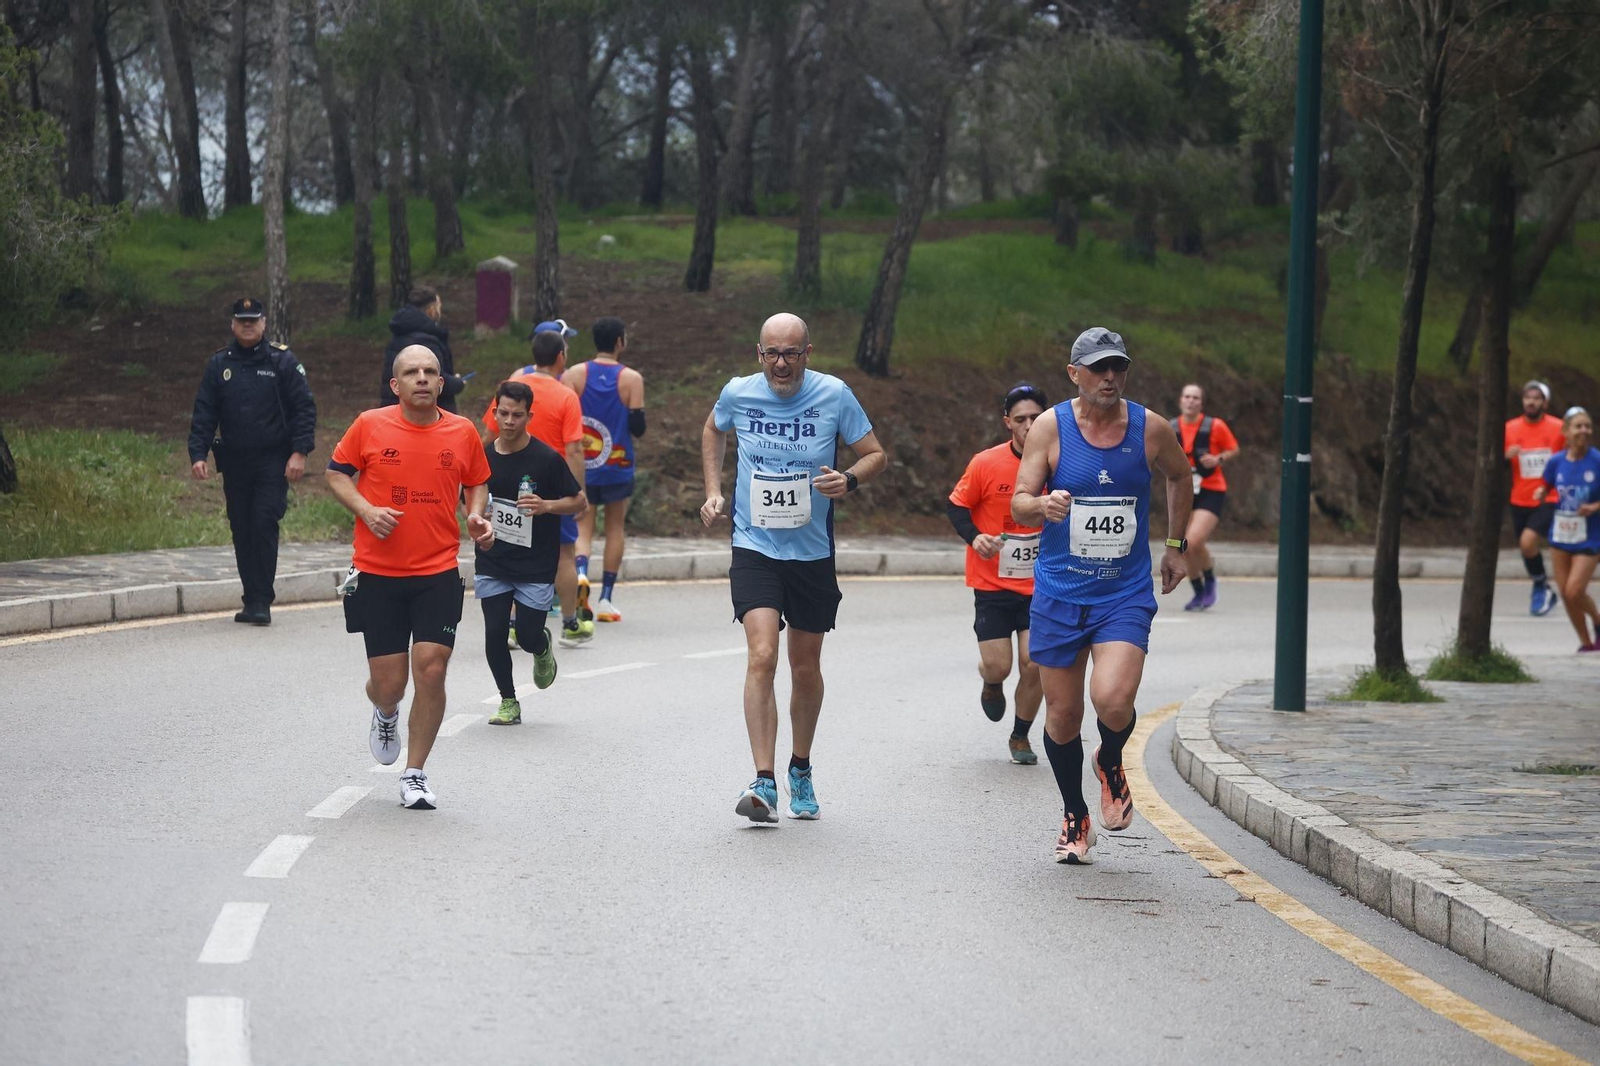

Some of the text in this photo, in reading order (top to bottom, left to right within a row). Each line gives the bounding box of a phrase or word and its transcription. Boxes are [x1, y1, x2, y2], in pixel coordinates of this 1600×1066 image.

[748, 417, 817, 442] nerja
[755, 440, 808, 452] ATLETISMO
[420, 497, 442, 505] Málaga
[762, 489, 798, 507] 341
[496, 510, 523, 529] 384
[1084, 515, 1125, 535] 448
[1011, 546, 1039, 562] 435
[1067, 565, 1095, 576] mayoral
